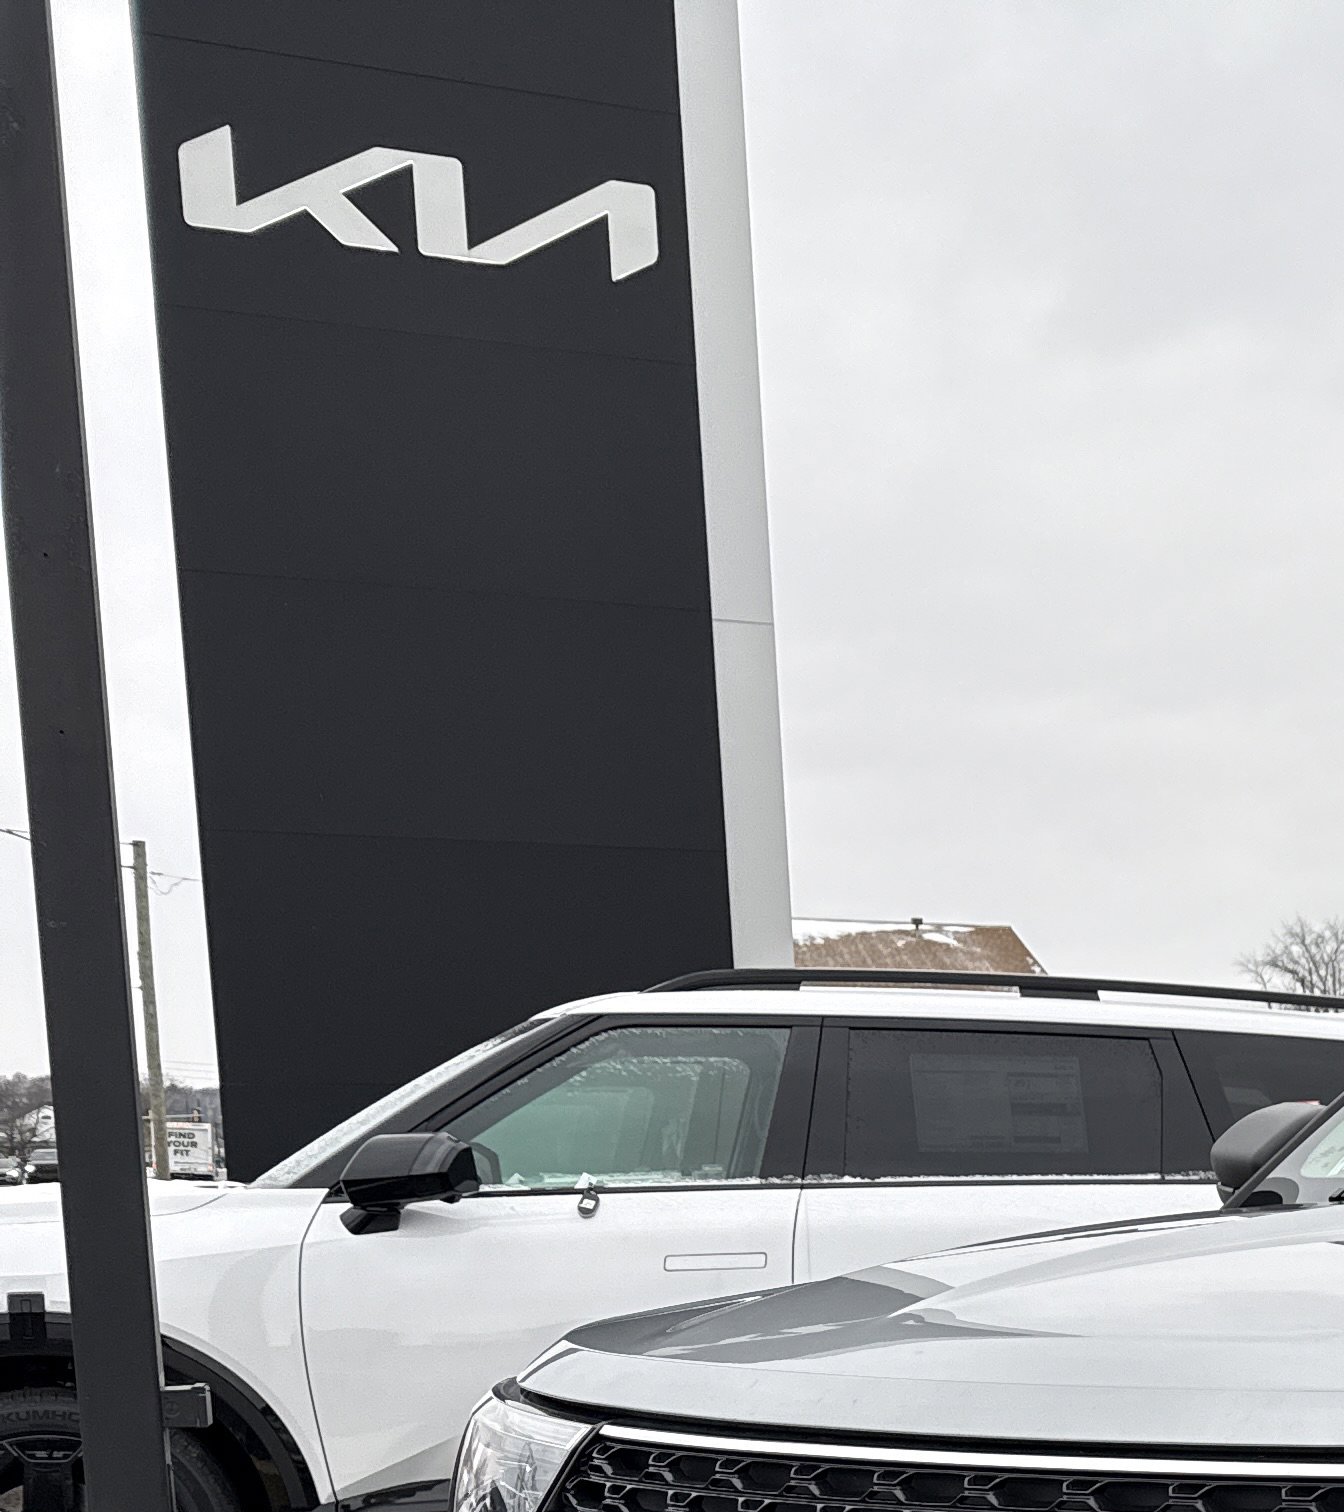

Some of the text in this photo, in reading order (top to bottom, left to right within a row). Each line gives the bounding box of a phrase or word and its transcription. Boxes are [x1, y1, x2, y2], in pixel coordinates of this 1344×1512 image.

[178, 124, 659, 283] KIA
[167, 1131, 195, 1139] FIND
[167, 1140, 198, 1148] YOUR
[173, 1148, 191, 1157] FIT
